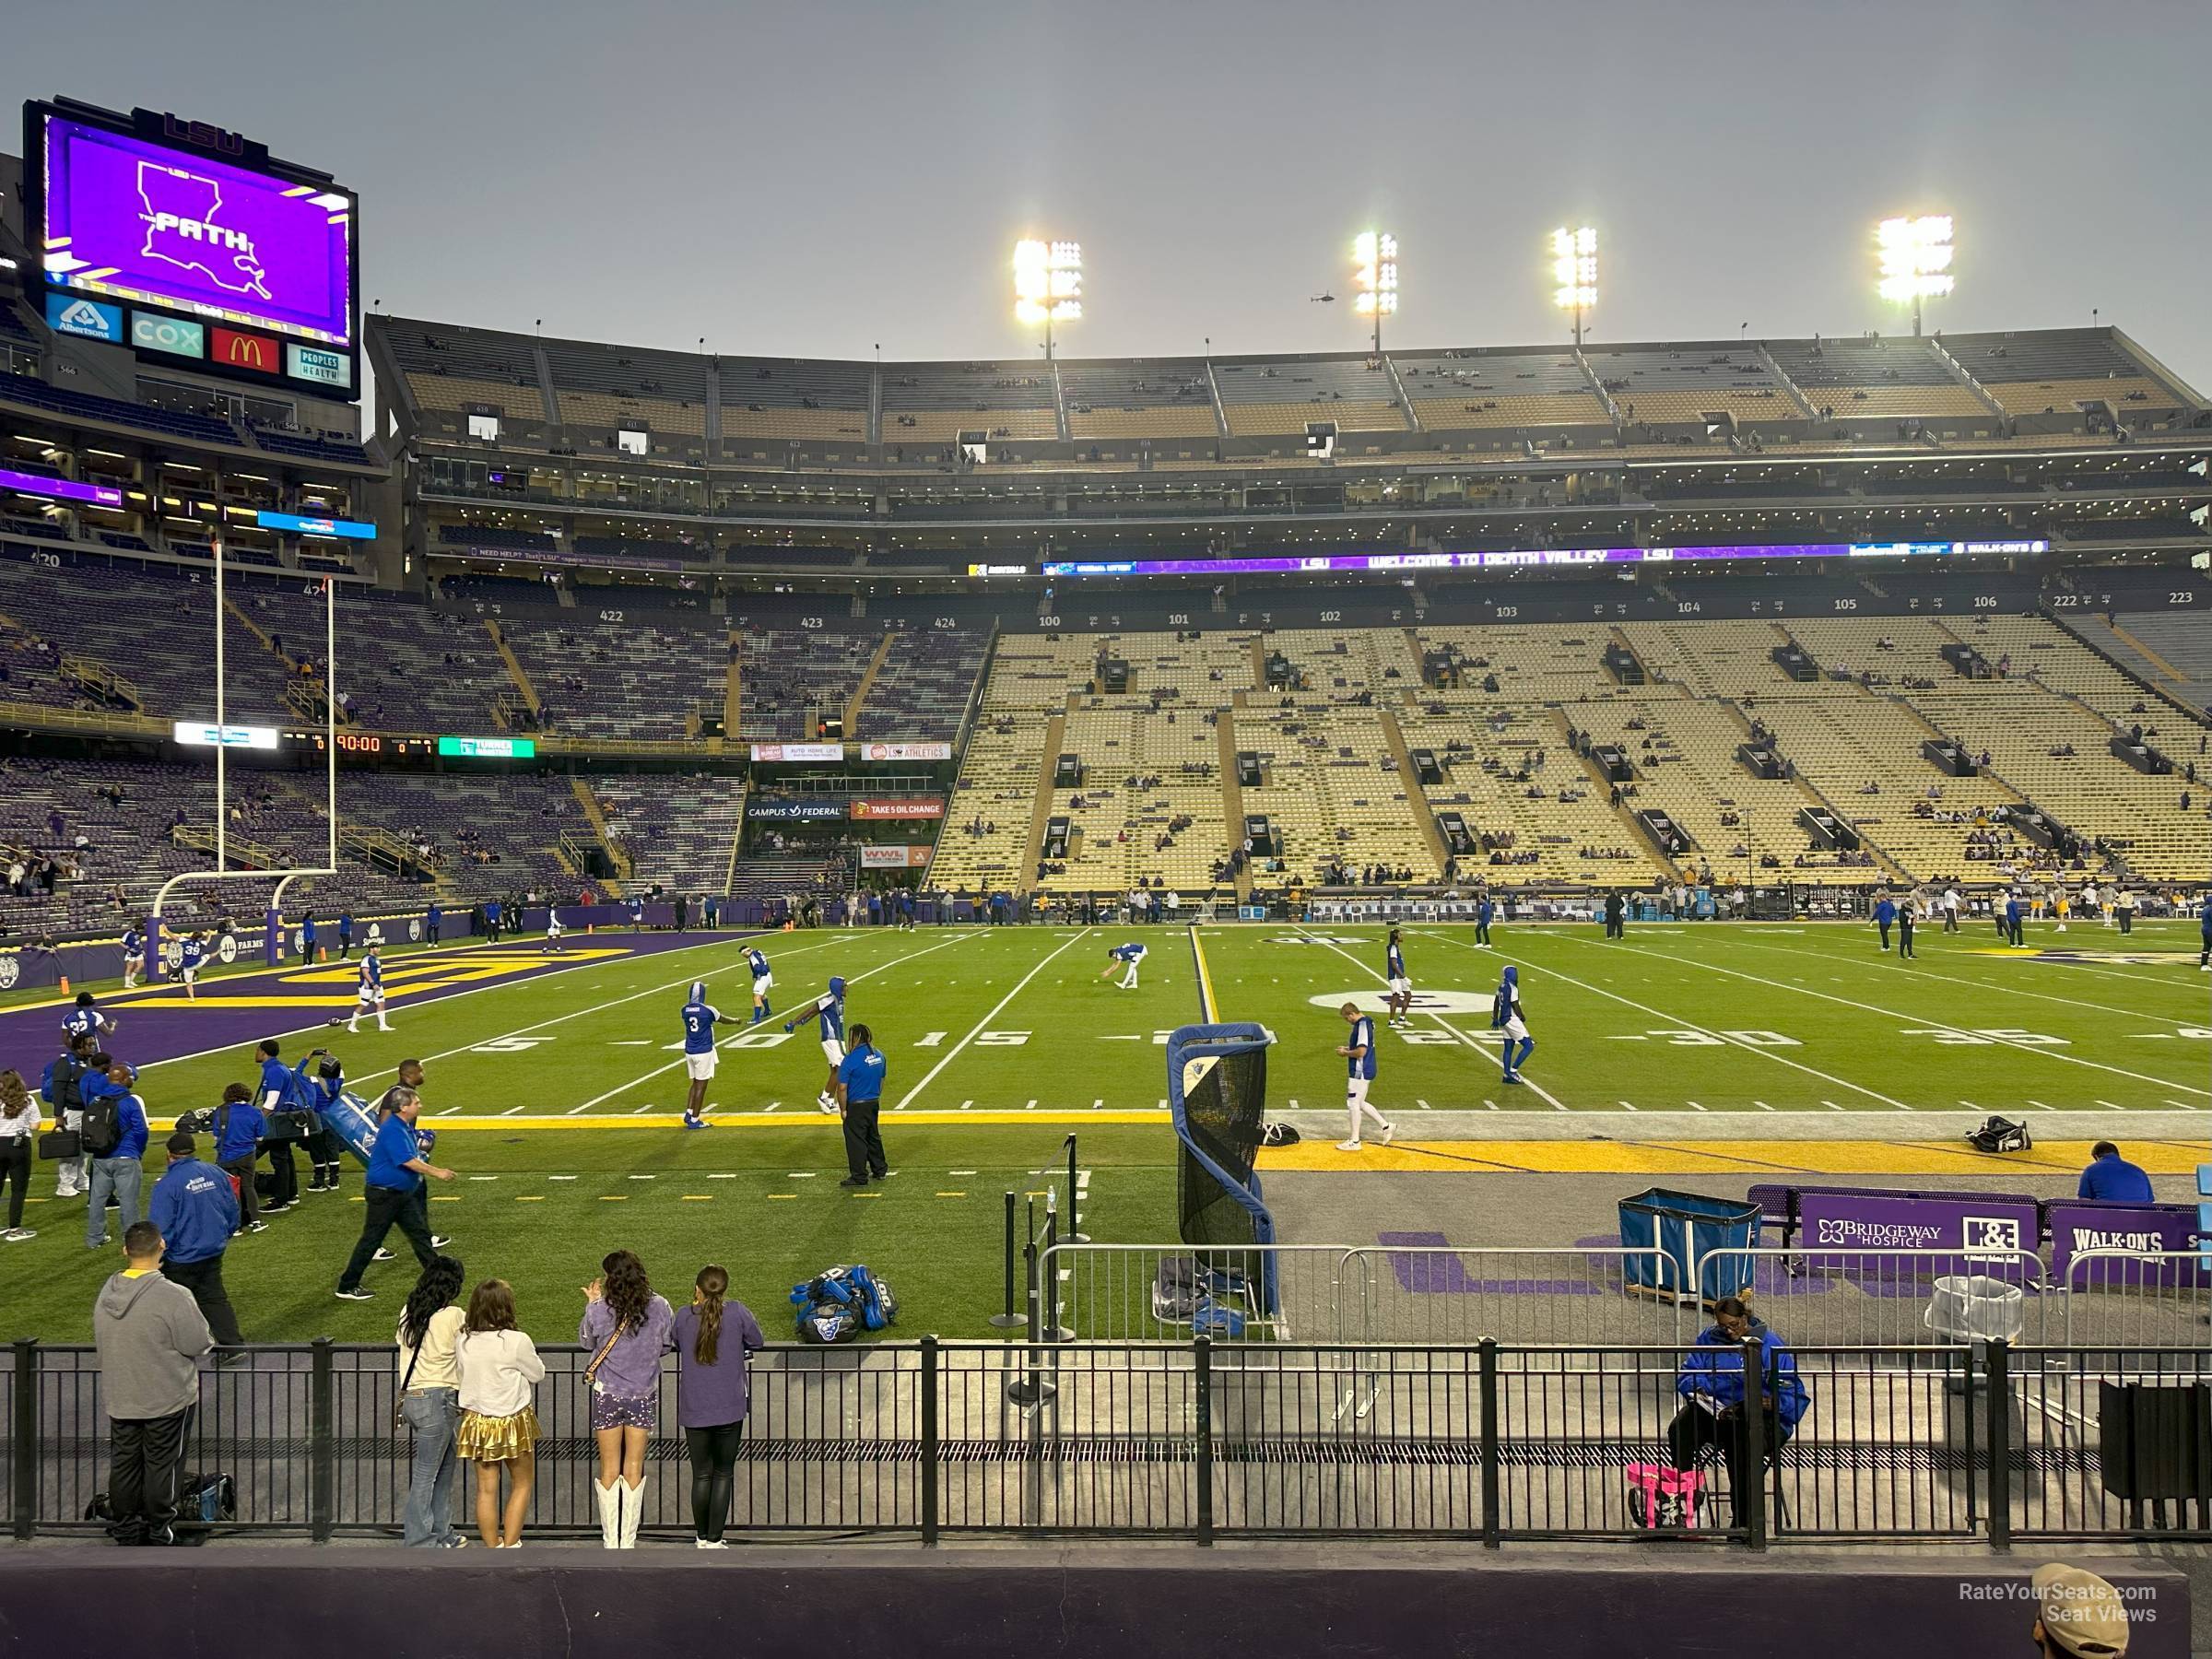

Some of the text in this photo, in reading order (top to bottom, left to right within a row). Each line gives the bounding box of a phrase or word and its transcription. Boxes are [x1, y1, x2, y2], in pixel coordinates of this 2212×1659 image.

[164, 112, 243, 156] LSU
[156, 212, 248, 252] PATH
[59, 322, 110, 340] Albertsons
[135, 320, 200, 350] COX
[301, 352, 338, 368] PEOPLES
[301, 366, 338, 380] HEALTH
[1643, 548, 1674, 560] LSU
[1968, 543, 2030, 553] WALK-ON'S
[1300, 559, 1330, 570] LSU
[1368, 549, 1607, 568] WELCOME TO DEATH VALLEY
[1834, 599, 1857, 610] 105
[1974, 596, 1997, 607] 106
[2053, 595, 2077, 606] 222
[2169, 593, 2193, 604] 223
[1496, 606, 1518, 617] 103
[1677, 602, 1700, 613] 104
[600, 610, 624, 621] 422
[1039, 616, 1060, 627] 100
[1169, 614, 1189, 625] 101
[1320, 611, 1341, 622] 102
[801, 618, 823, 628] 423
[935, 618, 956, 628] 424
[317, 739, 324, 750] 0
[336, 735, 379, 752] 90:00
[399, 744, 406, 753] 0
[905, 747, 944, 759] ATHLETICS
[748, 807, 840, 817] CAMPUS FEDERAL
[897, 806, 908, 814] OIL
[908, 805, 940, 814] CHANGE
[238, 938, 264, 950] FARMS
[185, 946, 200, 957] 39
[69, 1020, 88, 1036] 32
[689, 1017, 700, 1032] 3
[912, 1030, 1033, 1047] 15
[1646, 1030, 1803, 1045] 30
[1900, 1029, 2073, 1044] 35
[471, 1037, 557, 1052] 5
[1843, 1219, 1942, 1241] BRIDGEWAY
[1965, 1219, 2017, 1251] H&E
[1861, 1233, 1923, 1248] HOSPICE
